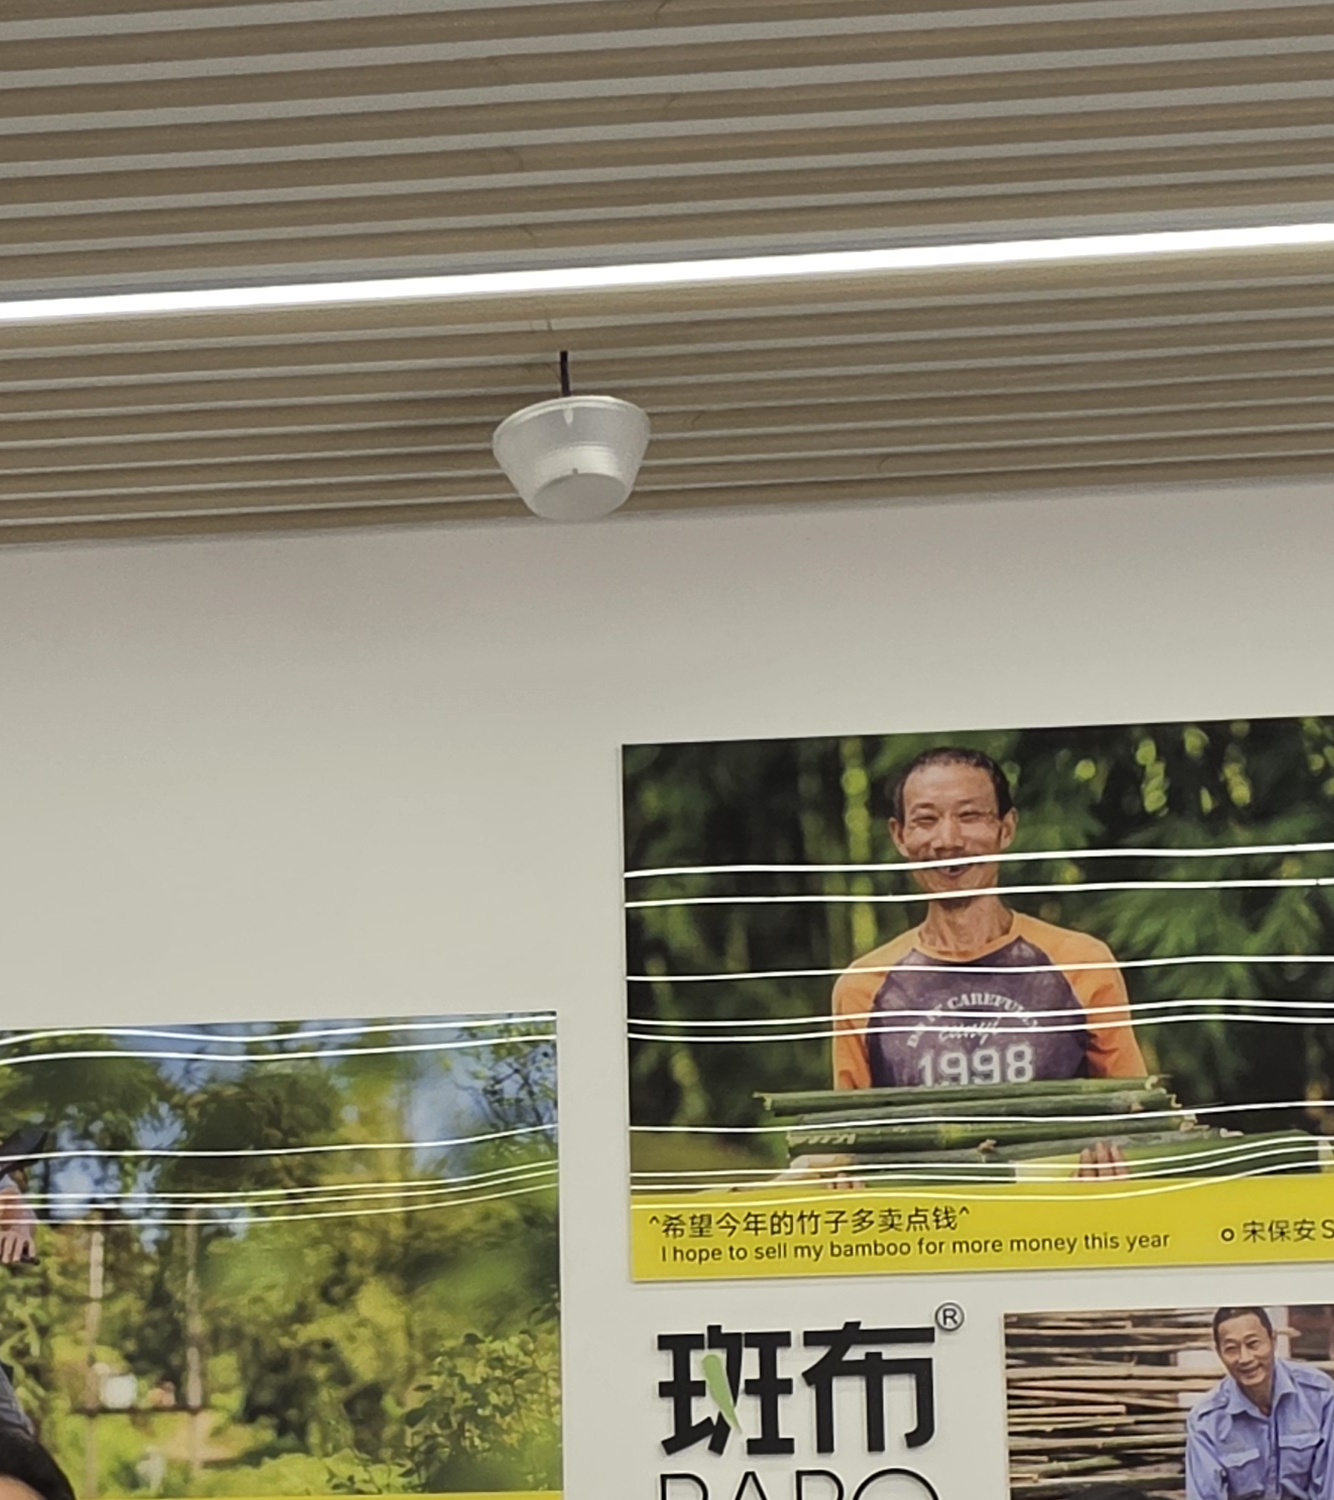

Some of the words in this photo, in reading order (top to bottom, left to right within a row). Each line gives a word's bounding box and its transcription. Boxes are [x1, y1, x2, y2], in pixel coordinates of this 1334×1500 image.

[918, 1042, 1035, 1088] 1998
[661, 1245, 667, 1262] I
[673, 1246, 722, 1264] hope
[729, 1244, 748, 1261] to
[754, 1242, 787, 1260] sell
[794, 1243, 824, 1261] my
[830, 1238, 911, 1258] bamboo
[918, 1237, 945, 1255] for
[952, 1238, 1003, 1255] more
[1010, 1236, 1078, 1254] money
[1084, 1231, 1120, 1250] this
[1126, 1233, 1170, 1253] year
[1242, 1218, 1316, 1243] 宋保安
[657, 1320, 935, 1456] 斑布
